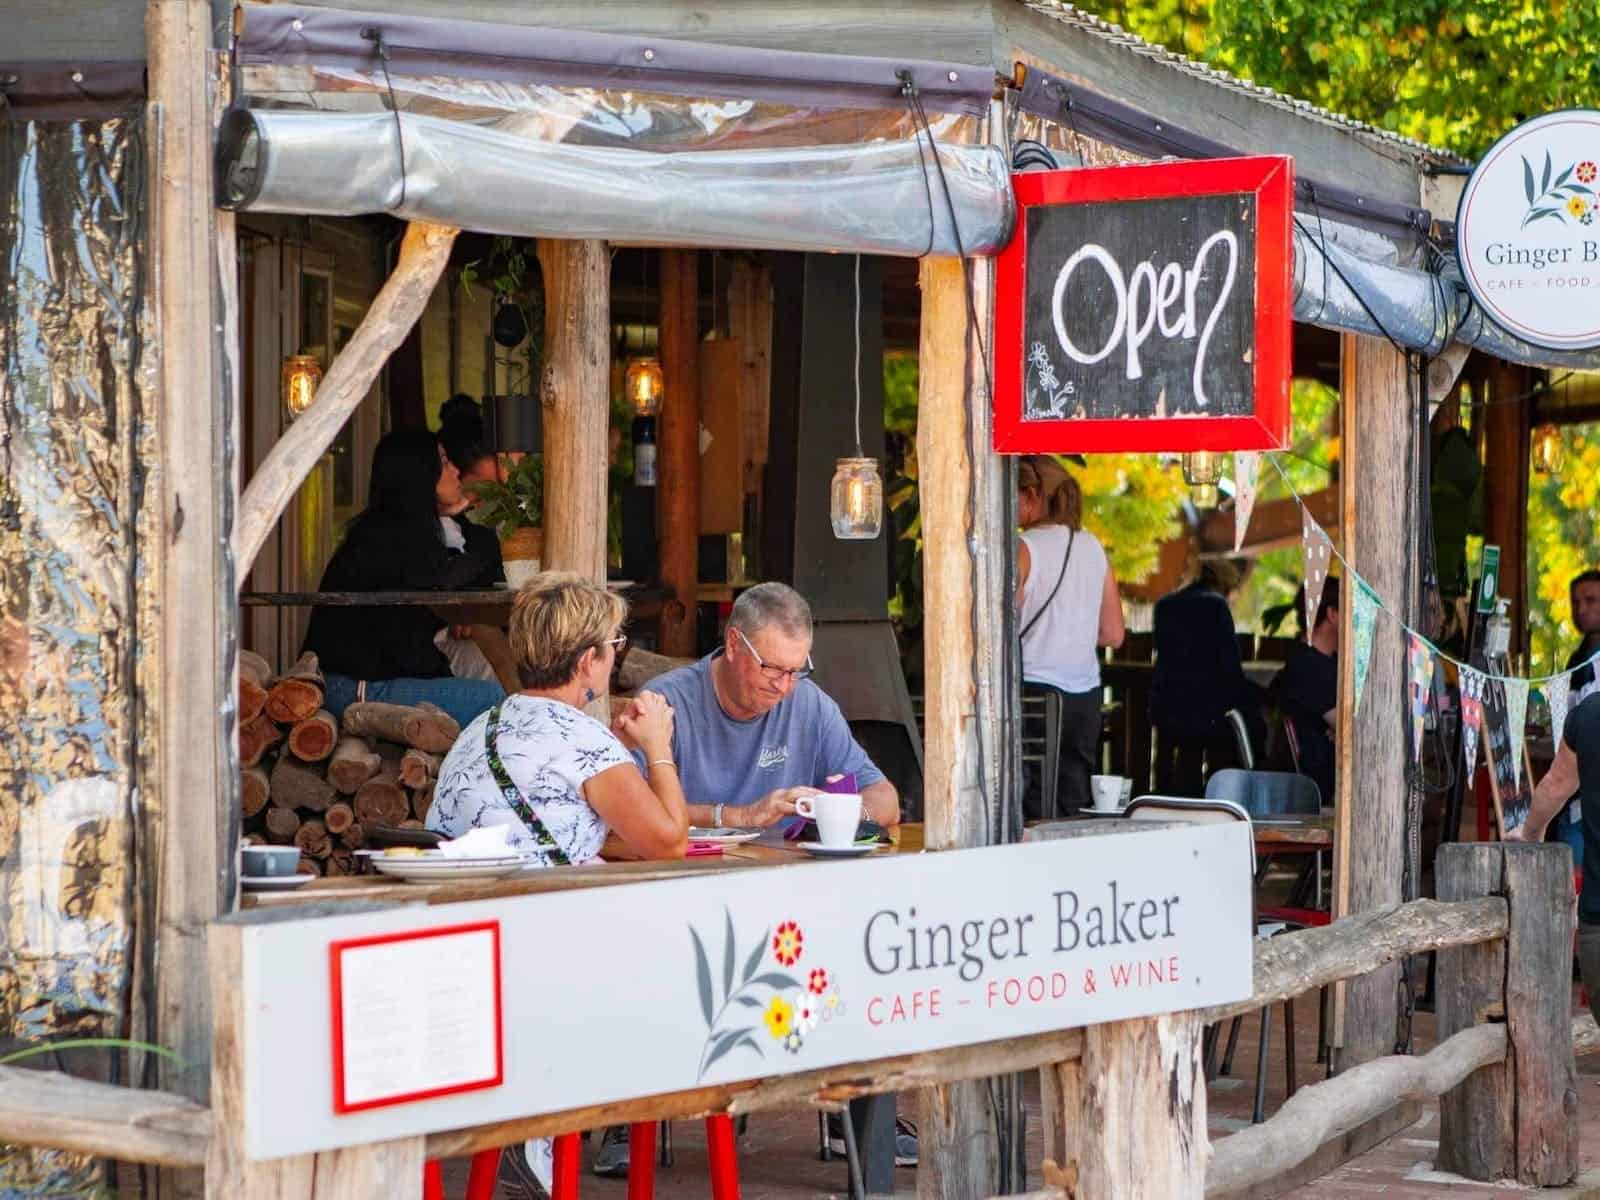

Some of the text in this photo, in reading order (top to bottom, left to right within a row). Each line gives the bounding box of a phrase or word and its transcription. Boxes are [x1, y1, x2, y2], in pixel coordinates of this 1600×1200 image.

[1485, 240, 1600, 270] Ginger B
[1487, 279, 1524, 289] CAFE
[1546, 277, 1591, 288] FOOD
[1052, 230, 1238, 406] Open
[864, 879, 1180, 983] Ginger Baker
[867, 989, 942, 1026] CAFE
[987, 973, 1068, 1009] FOOD
[1083, 968, 1097, 994] &
[1111, 957, 1180, 988] WINE
